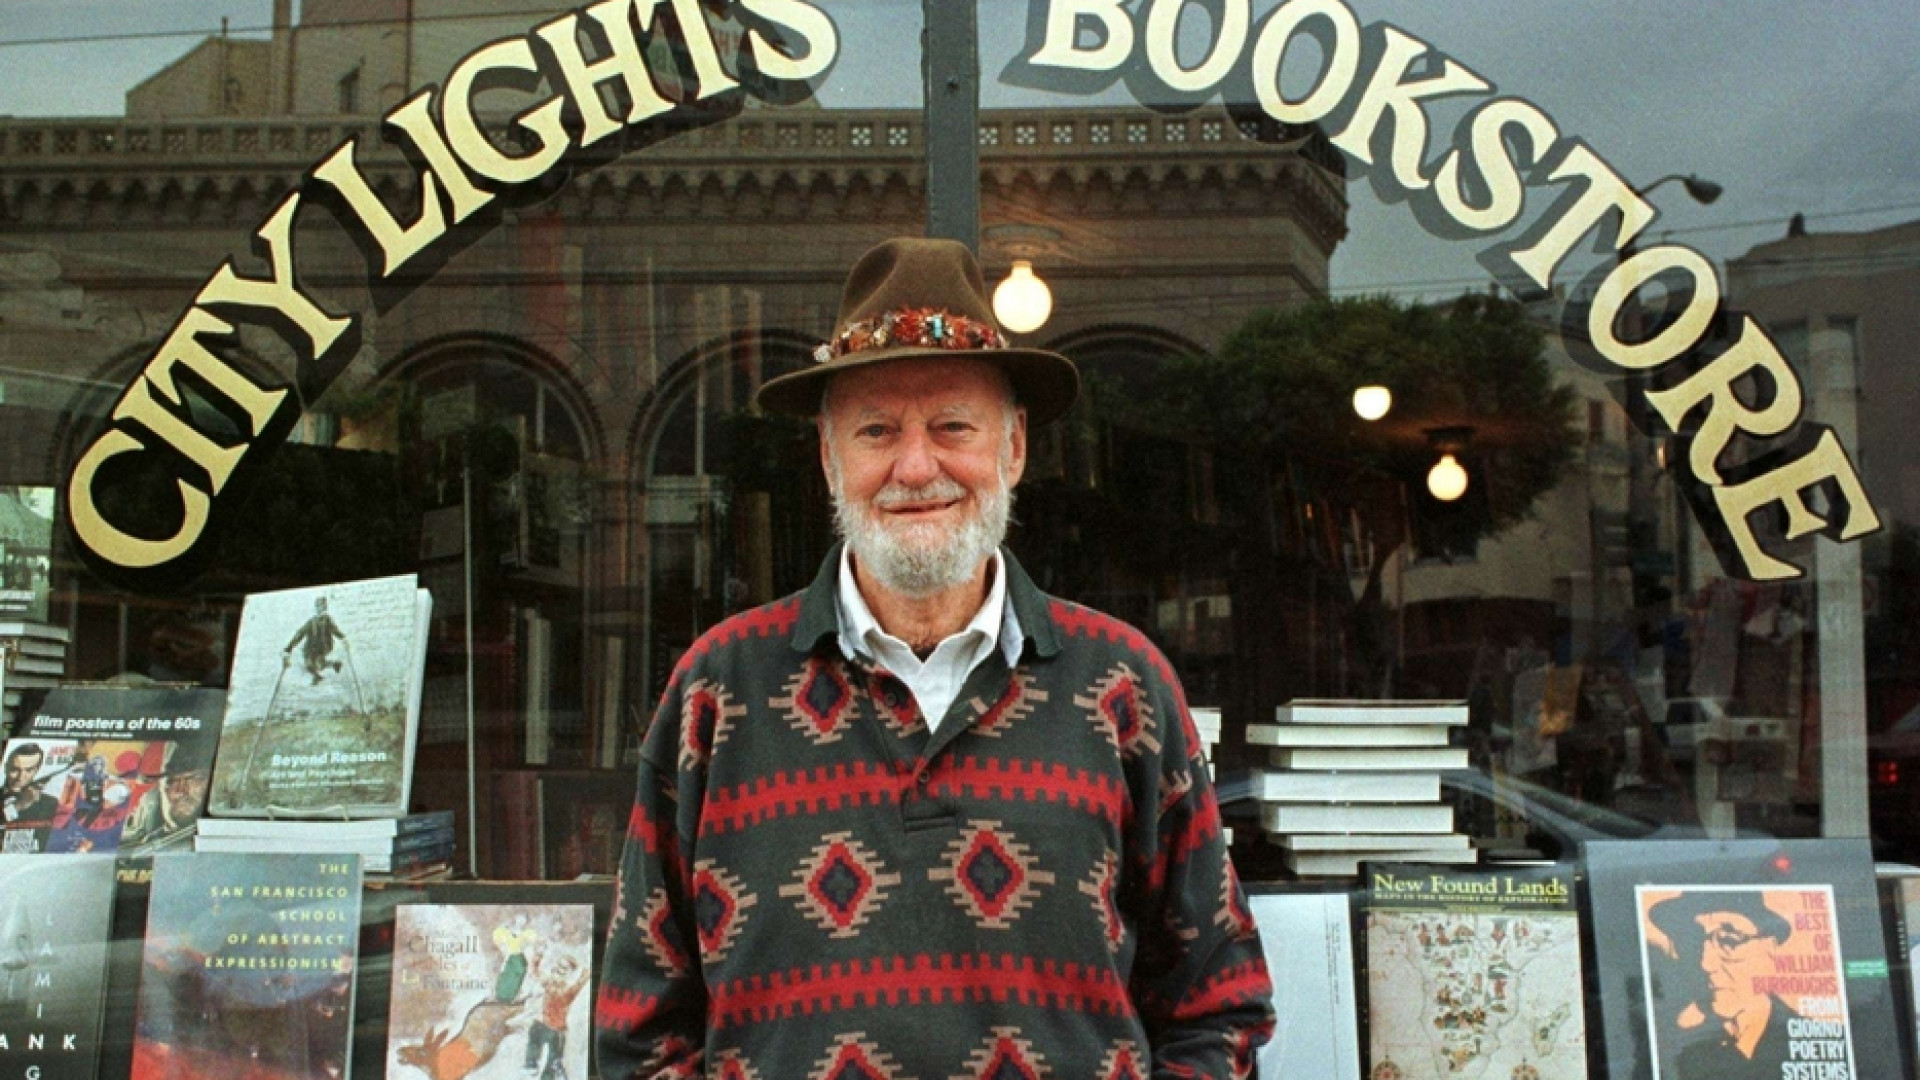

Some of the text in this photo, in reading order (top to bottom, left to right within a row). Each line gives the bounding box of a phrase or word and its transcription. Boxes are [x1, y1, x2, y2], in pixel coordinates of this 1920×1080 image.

[69, 0, 838, 567] CITY LIGHTS
[1028, 0, 1881, 579] BOOKSTORE
[34, 715, 201, 731] film posters of the 60s
[272, 751, 387, 768] Beyond Reason
[319, 863, 348, 875] THE
[211, 886, 347, 898] SAN FRANCISCO
[1373, 873, 1568, 896] New Found Lands
[1800, 892, 1826, 910] THE
[279, 910, 346, 921] SCHOOL
[1794, 913, 1829, 931] BEST
[227, 933, 344, 945] OF ABSTRACT
[409, 934, 479, 958] Chagall
[1813, 934, 1831, 951] OF
[205, 956, 343, 970] EXPRESSIONISM
[1773, 956, 1836, 972] WILLIAM
[1752, 976, 1839, 995] BURROUGHS
[1799, 998, 1840, 1016] FROM
[1787, 1018, 1844, 1038] GIORNO
[1789, 1040, 1846, 1060] POETRY
[1782, 1061, 1850, 1080] SYSTEMS
